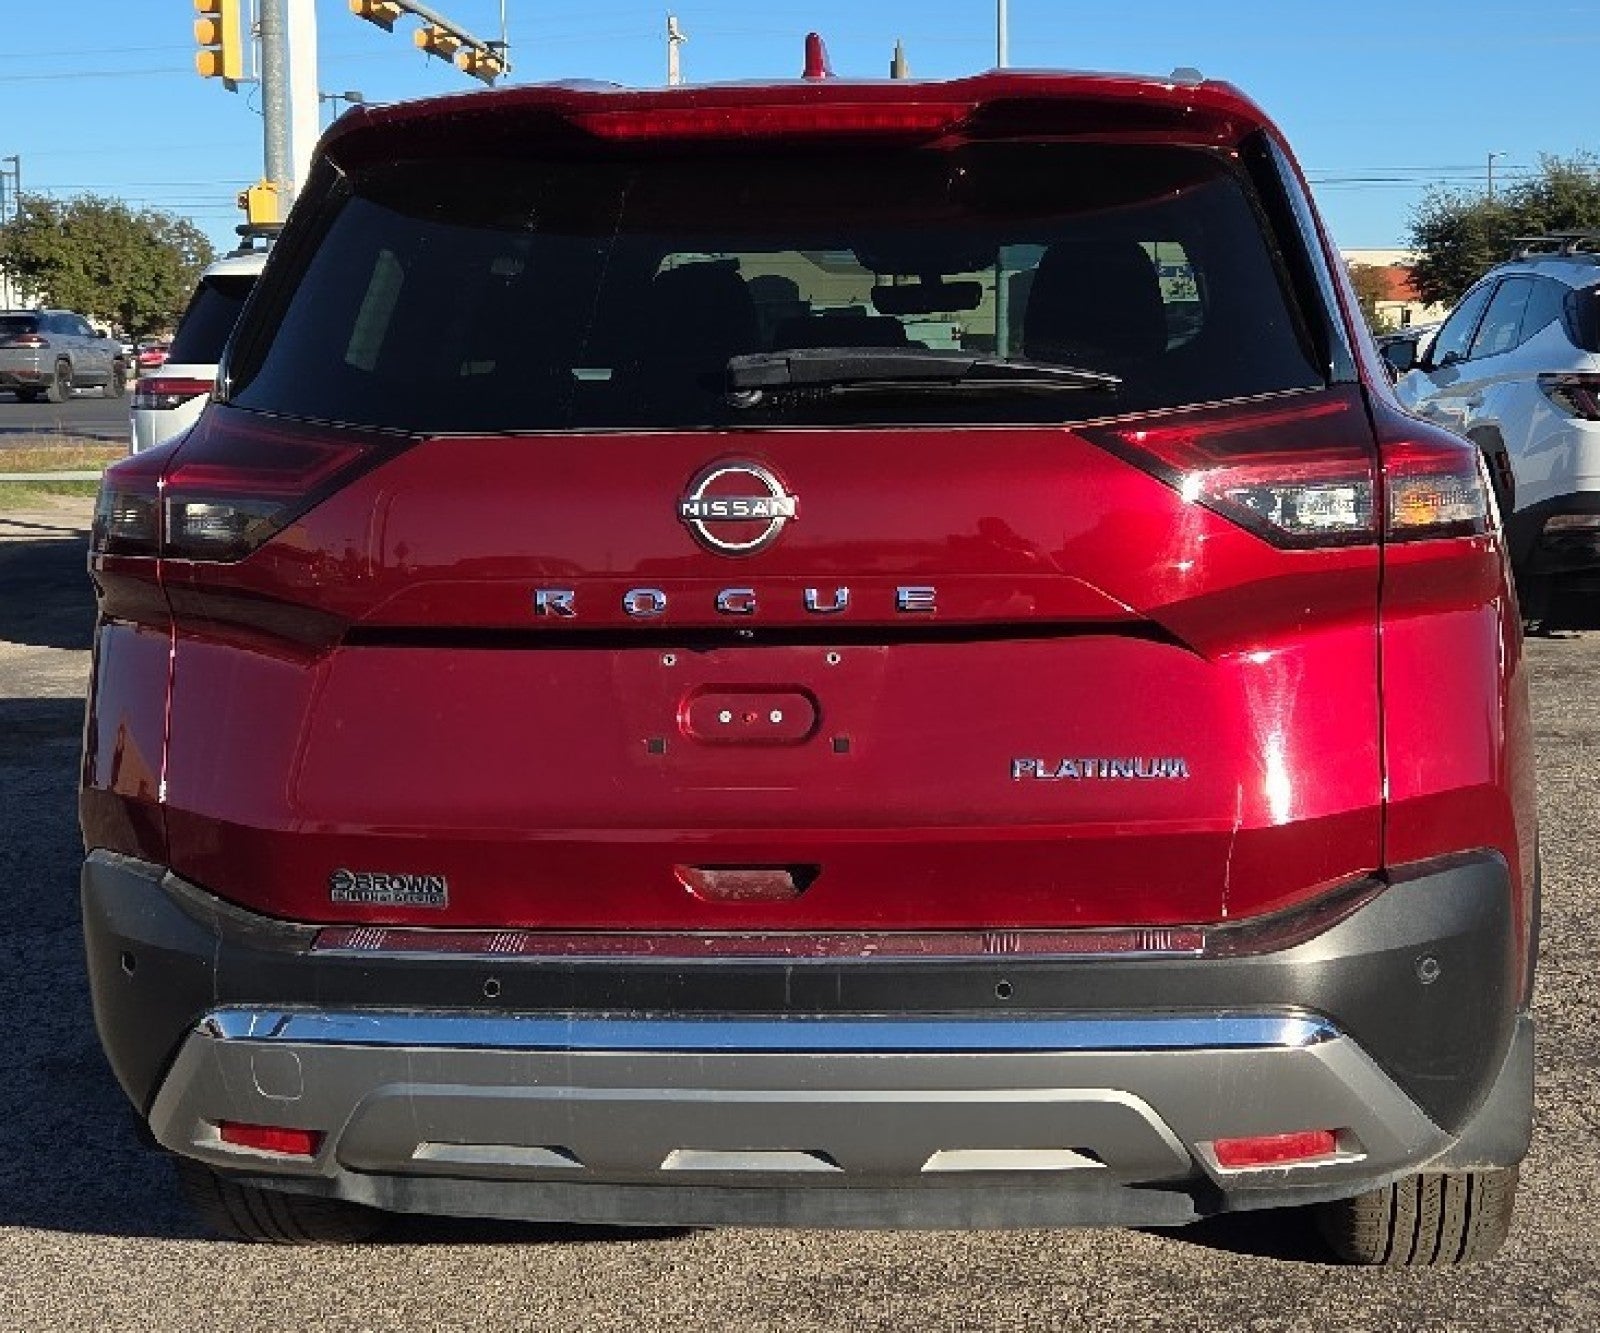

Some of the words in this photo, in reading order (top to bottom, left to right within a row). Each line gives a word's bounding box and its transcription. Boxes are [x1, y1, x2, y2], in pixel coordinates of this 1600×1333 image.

[682, 501, 792, 516] NISSAN
[534, 586, 937, 616] ROGUE
[1011, 757, 1191, 780] PLATINUM
[356, 873, 445, 892] BROWN
